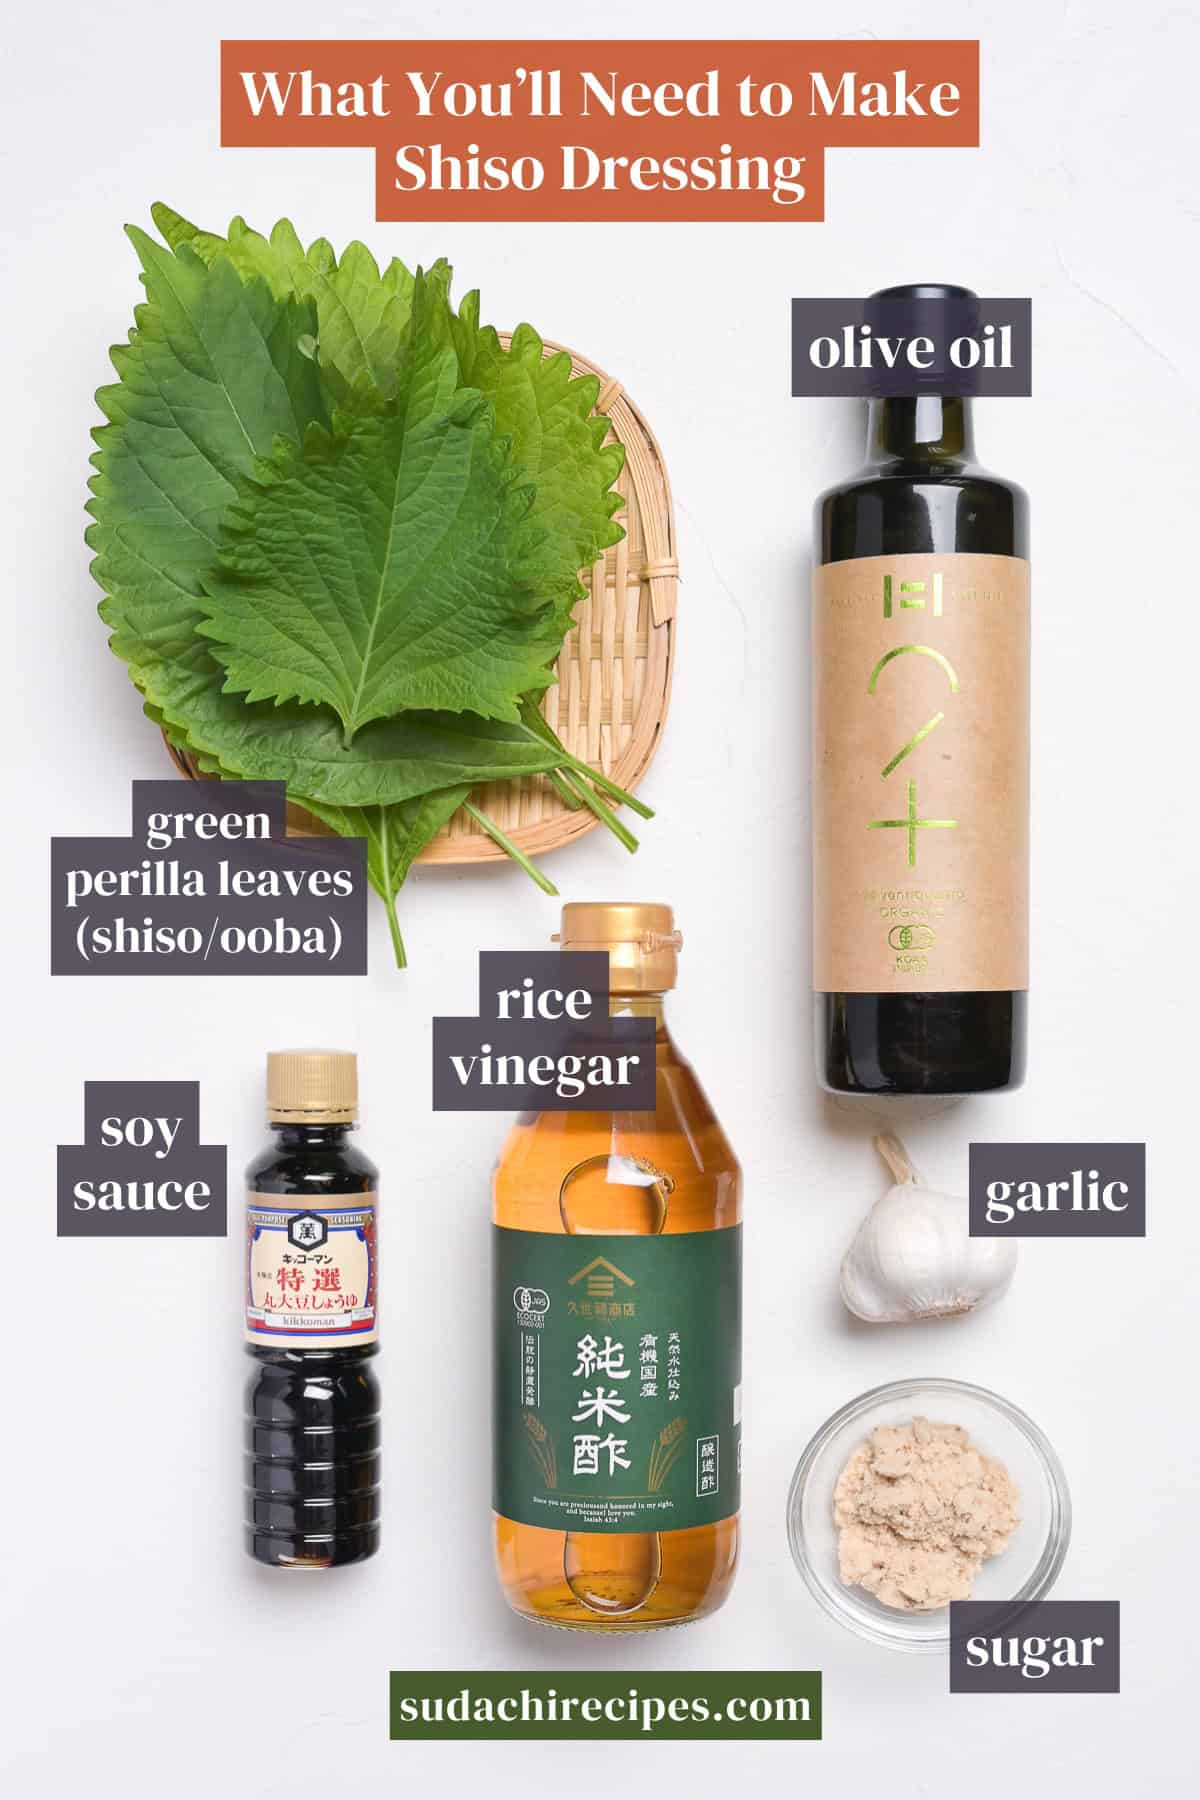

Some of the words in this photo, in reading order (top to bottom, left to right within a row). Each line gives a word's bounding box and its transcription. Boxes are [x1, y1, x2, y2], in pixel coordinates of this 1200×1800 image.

[282, 1254, 333, 1264] キッコーマン
[276, 1267, 342, 1292] 特選
[283, 1316, 335, 1326] kikkoman
[572, 1334, 632, 1477] 純米酢
